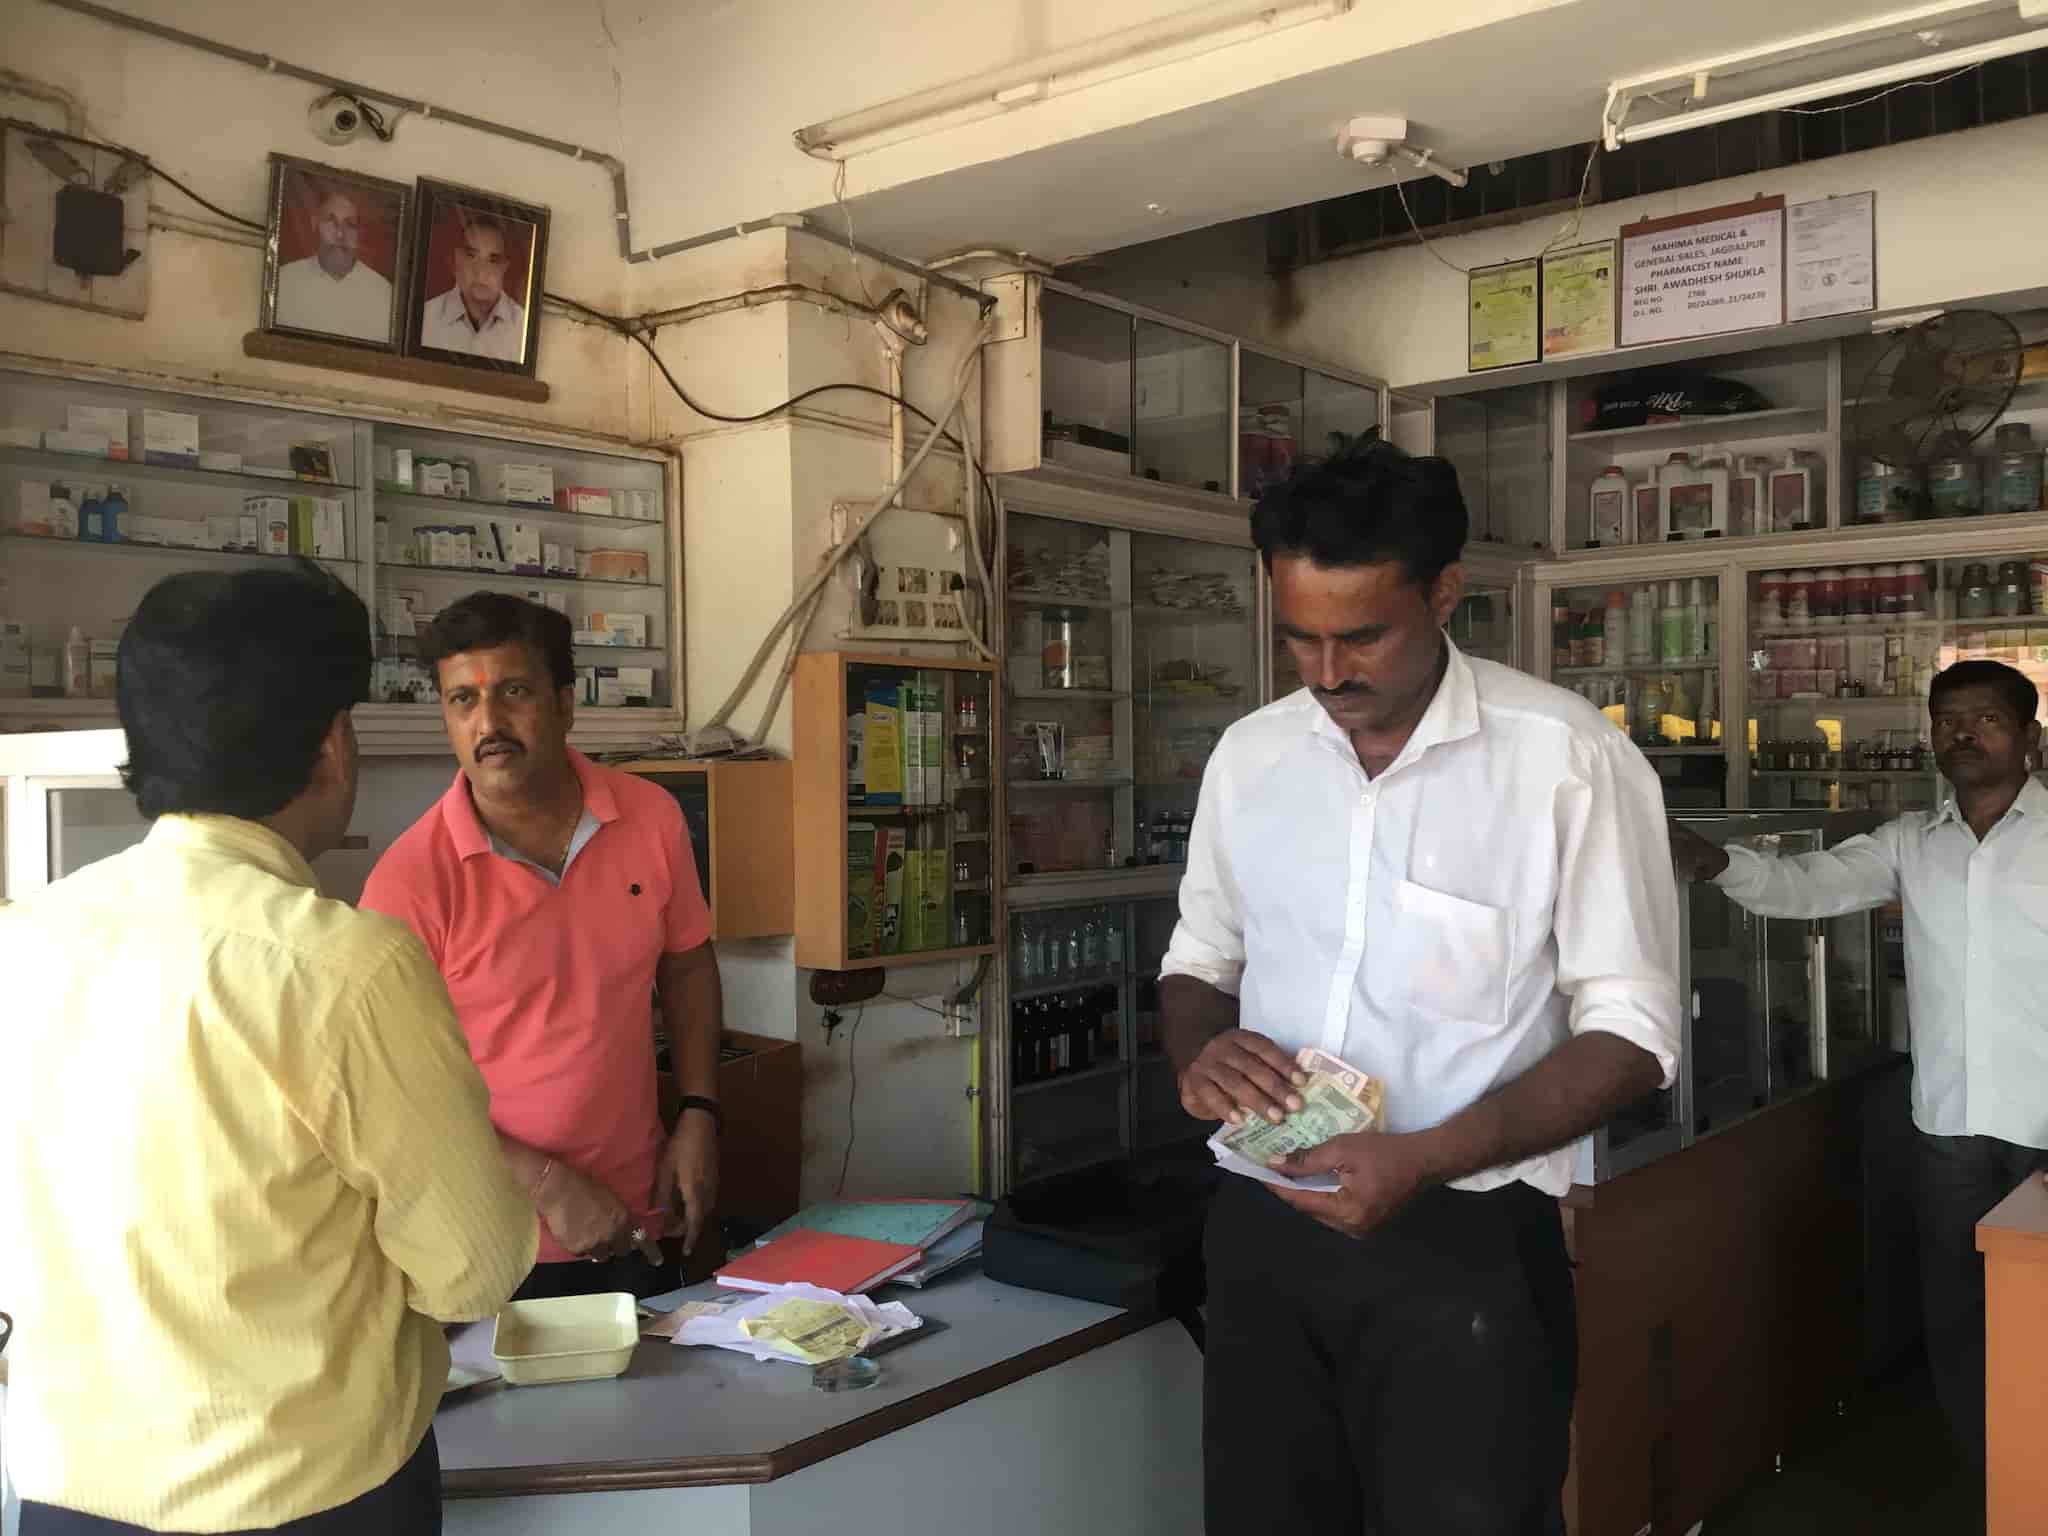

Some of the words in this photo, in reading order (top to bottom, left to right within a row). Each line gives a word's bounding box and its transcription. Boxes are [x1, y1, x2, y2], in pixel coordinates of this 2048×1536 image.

[1652, 239, 1693, 253] MAHIMA
[1695, 230, 1736, 245] MEDICAL
[1740, 229, 1747, 237] &
[1634, 254, 1675, 269] GENERAL
[1710, 240, 1766, 256] JAGDALPUR
[1650, 262, 1711, 278] PHARMACIST
[1714, 256, 1743, 268] NAME
[1662, 273, 1722, 290] AWADHESH
[1725, 266, 1766, 280] SHUKLA
